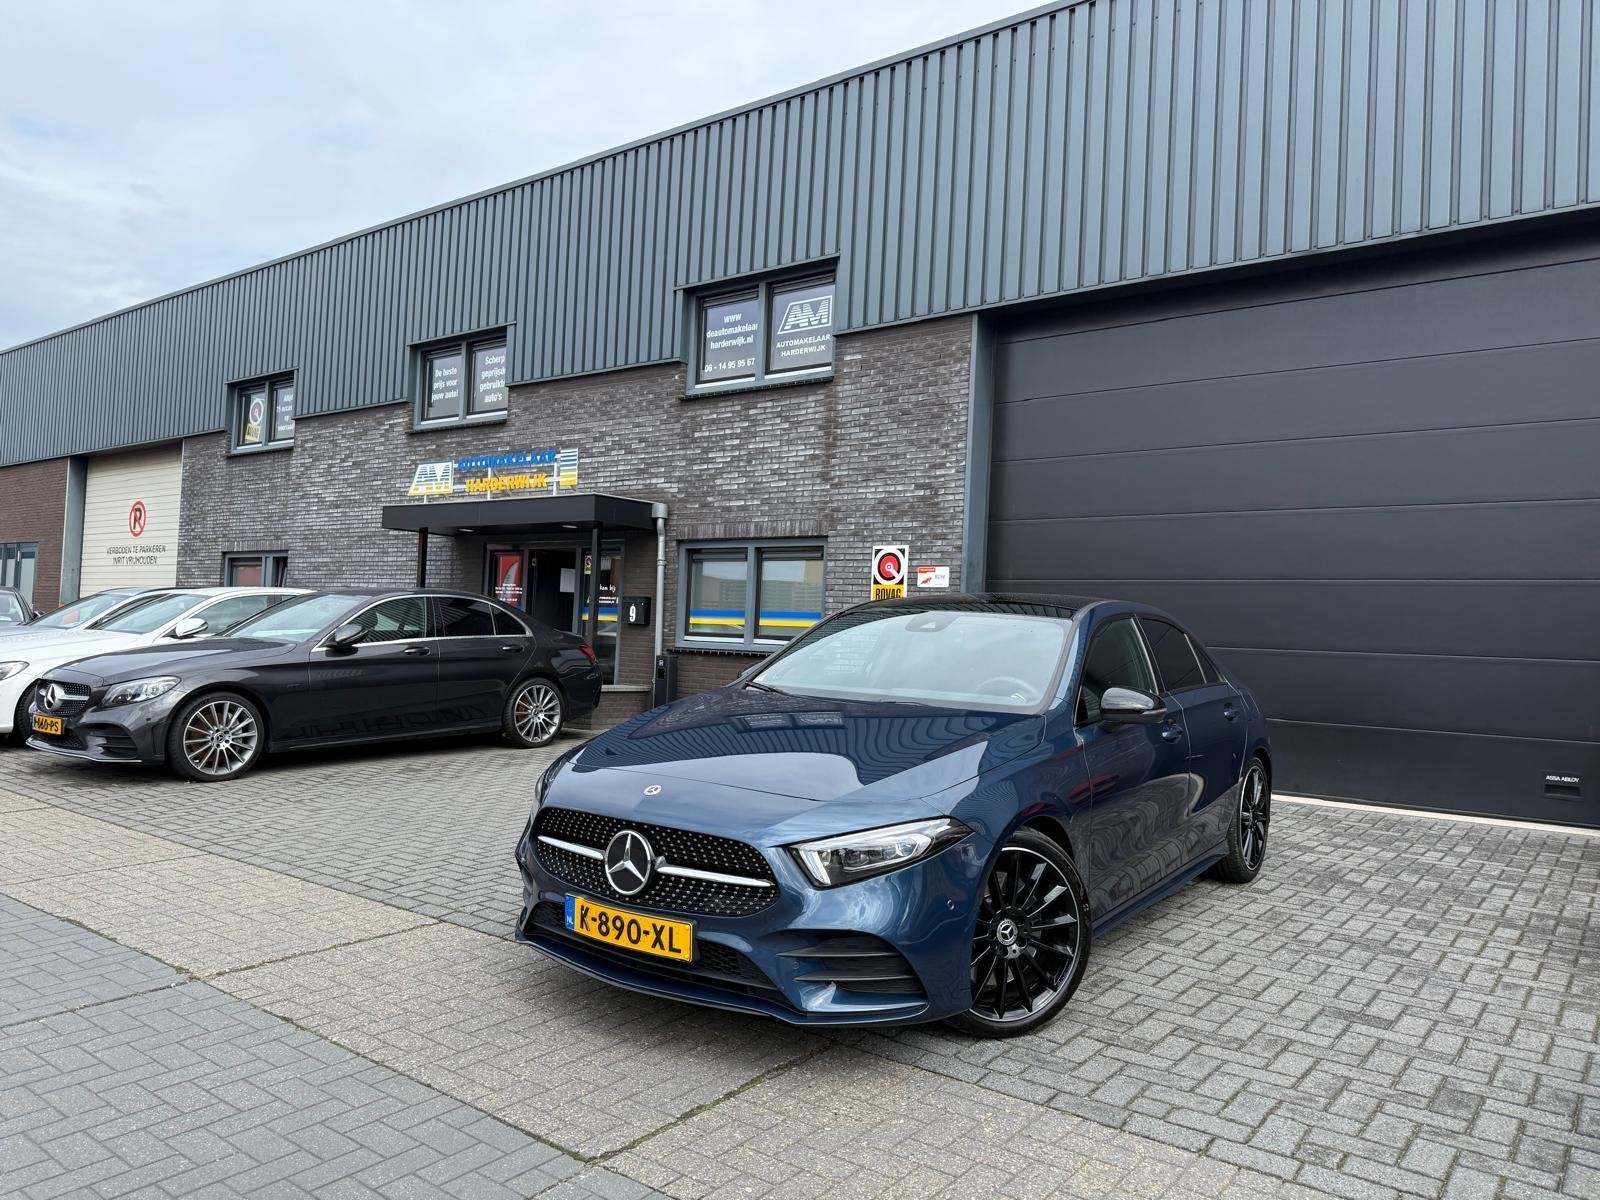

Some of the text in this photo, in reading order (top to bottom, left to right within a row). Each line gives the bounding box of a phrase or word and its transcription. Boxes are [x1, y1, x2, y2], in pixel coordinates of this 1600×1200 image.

[723, 312, 742, 324] www
[706, 323, 758, 338] deautomakelaar
[710, 334, 754, 350] harderwijk.nl
[776, 333, 831, 349] AUTOMAKELAAR
[781, 344, 826, 357] HARDERWIJK
[704, 363, 713, 373] 06
[719, 362, 727, 371] 14
[727, 360, 737, 370] 95
[737, 359, 746, 368] 95
[747, 357, 756, 367] 67
[465, 472, 548, 493] HARDERWIJK
[106, 546, 132, 555] VERBODEN
[138, 544, 166, 553] PARKEREN
[875, 588, 901, 600] BOVAG
[629, 605, 637, 622] 9
[579, 904, 682, 954] K-890-XL
